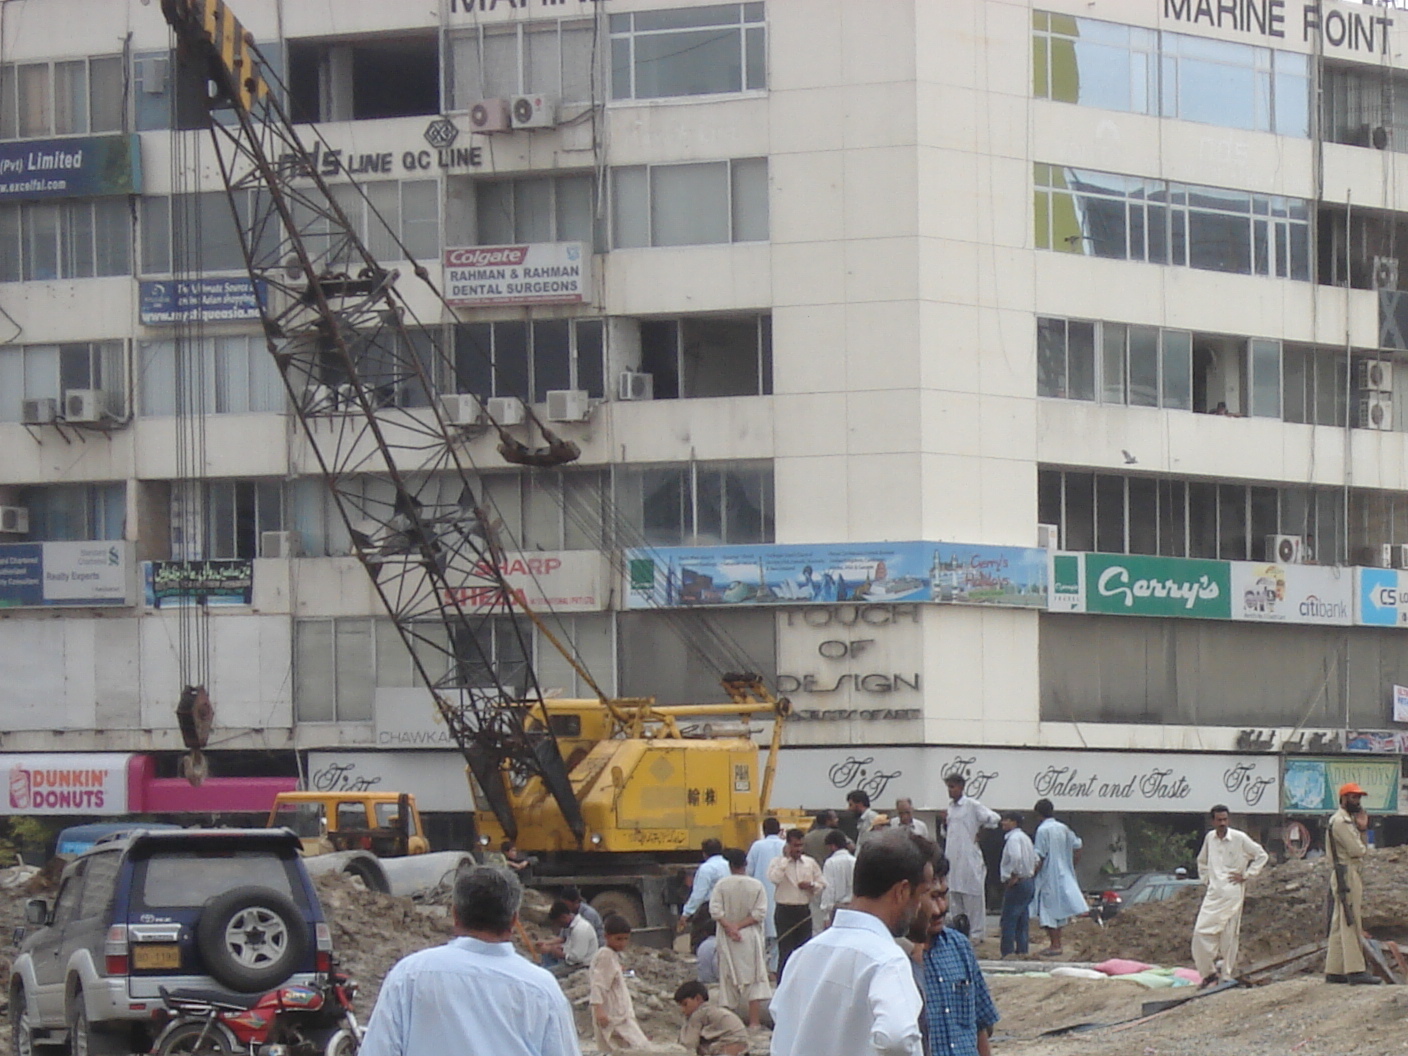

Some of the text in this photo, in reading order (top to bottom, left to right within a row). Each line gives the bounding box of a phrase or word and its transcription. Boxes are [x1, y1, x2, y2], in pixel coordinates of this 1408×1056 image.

[1164, 0, 1394, 55] MARINE POINT
[0, 150, 83, 174] (Pvt) Limited
[349, 152, 393, 174] LINE
[402, 151, 431, 171] QC
[438, 147, 482, 168] LINE
[450, 250, 522, 266] Colgate
[450, 265, 579, 282] RAHMAN & RAHMAN
[453, 280, 578, 296] DENTAL SURGEONS
[475, 558, 562, 576] SHARP
[1098, 566, 1220, 609] Gerry's
[1299, 594, 1348, 618] citibank
[1380, 588, 1397, 606] CS
[776, 672, 920, 693] DESIGN
[379, 731, 452, 744] CHAWKA
[33, 769, 108, 787] DUNKIN'
[1034, 765, 1191, 798] Talent and Taste
[33, 790, 104, 808] DONUTS
